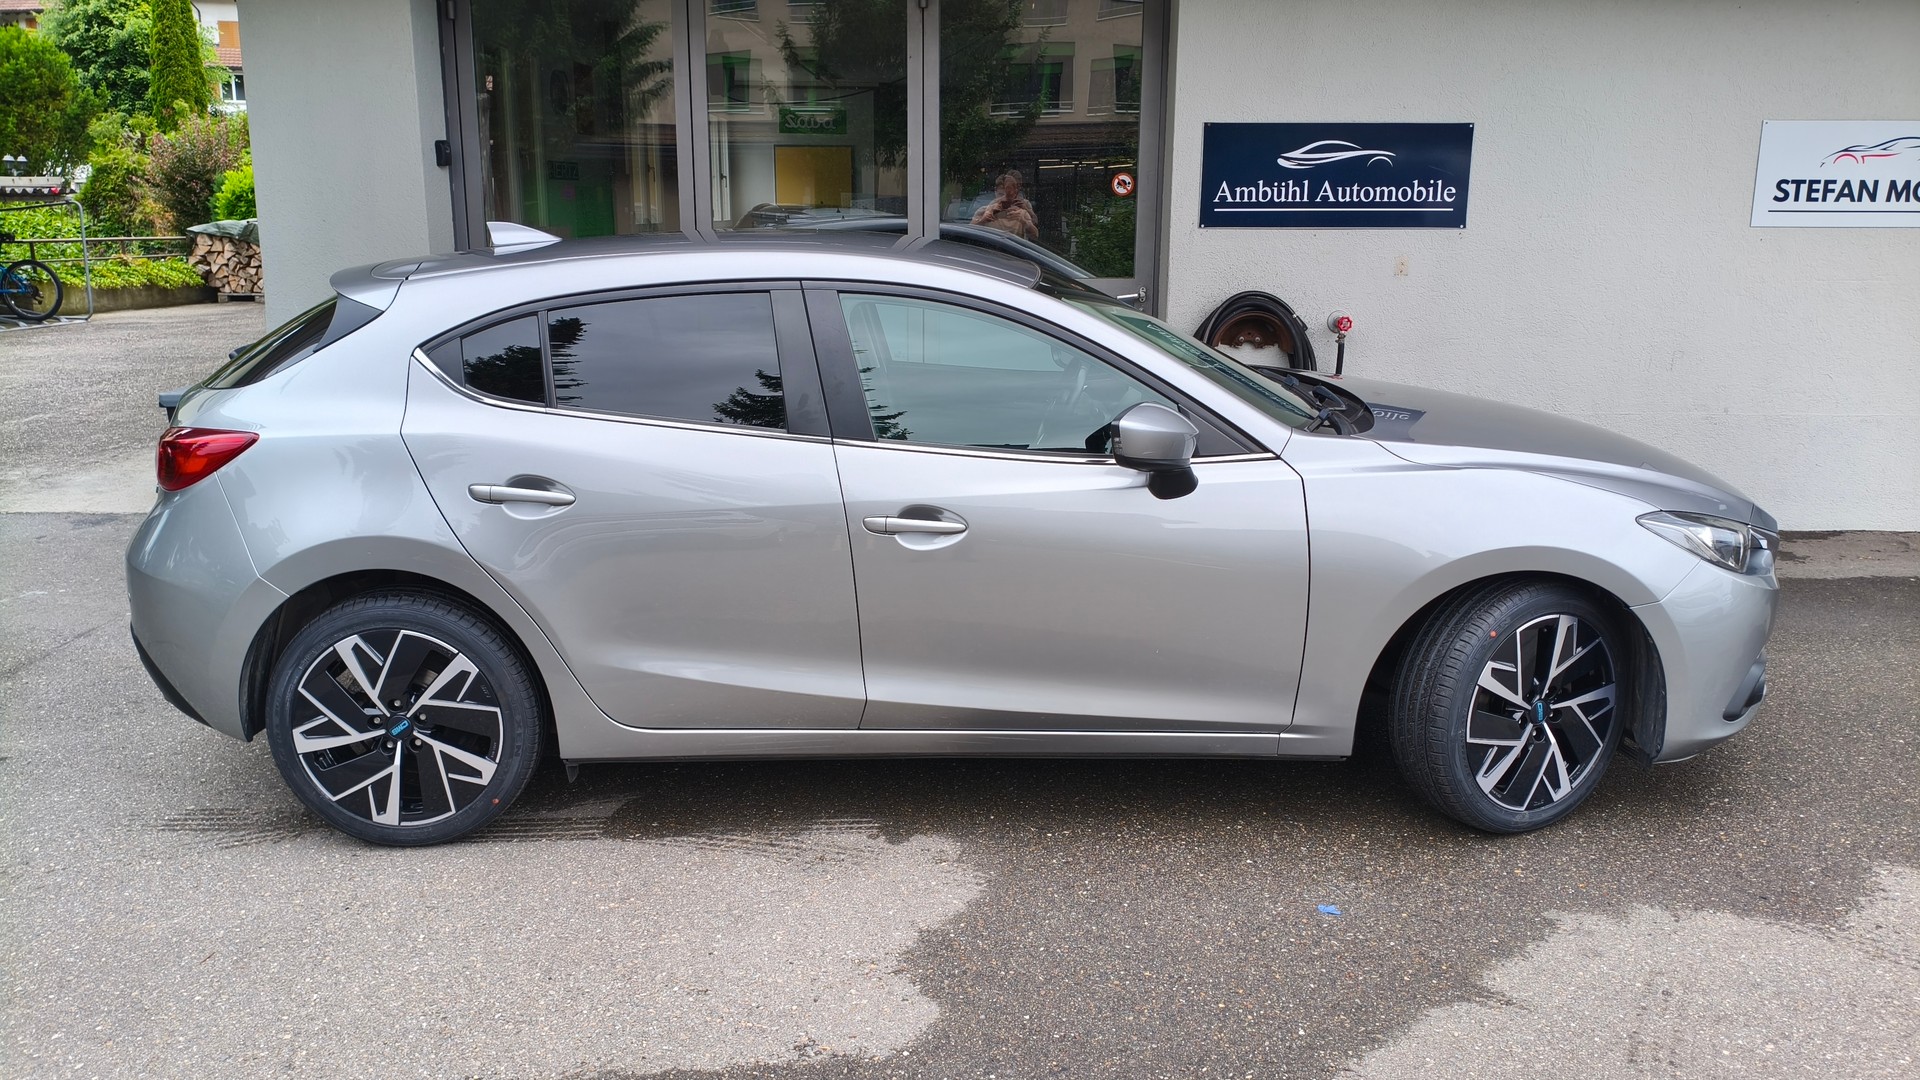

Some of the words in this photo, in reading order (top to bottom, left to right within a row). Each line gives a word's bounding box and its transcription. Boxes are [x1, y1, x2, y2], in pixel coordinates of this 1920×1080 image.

[1213, 180, 1309, 203] Ambühl
[1315, 179, 1456, 202] Automobile
[1772, 178, 1880, 203] STEFAN
